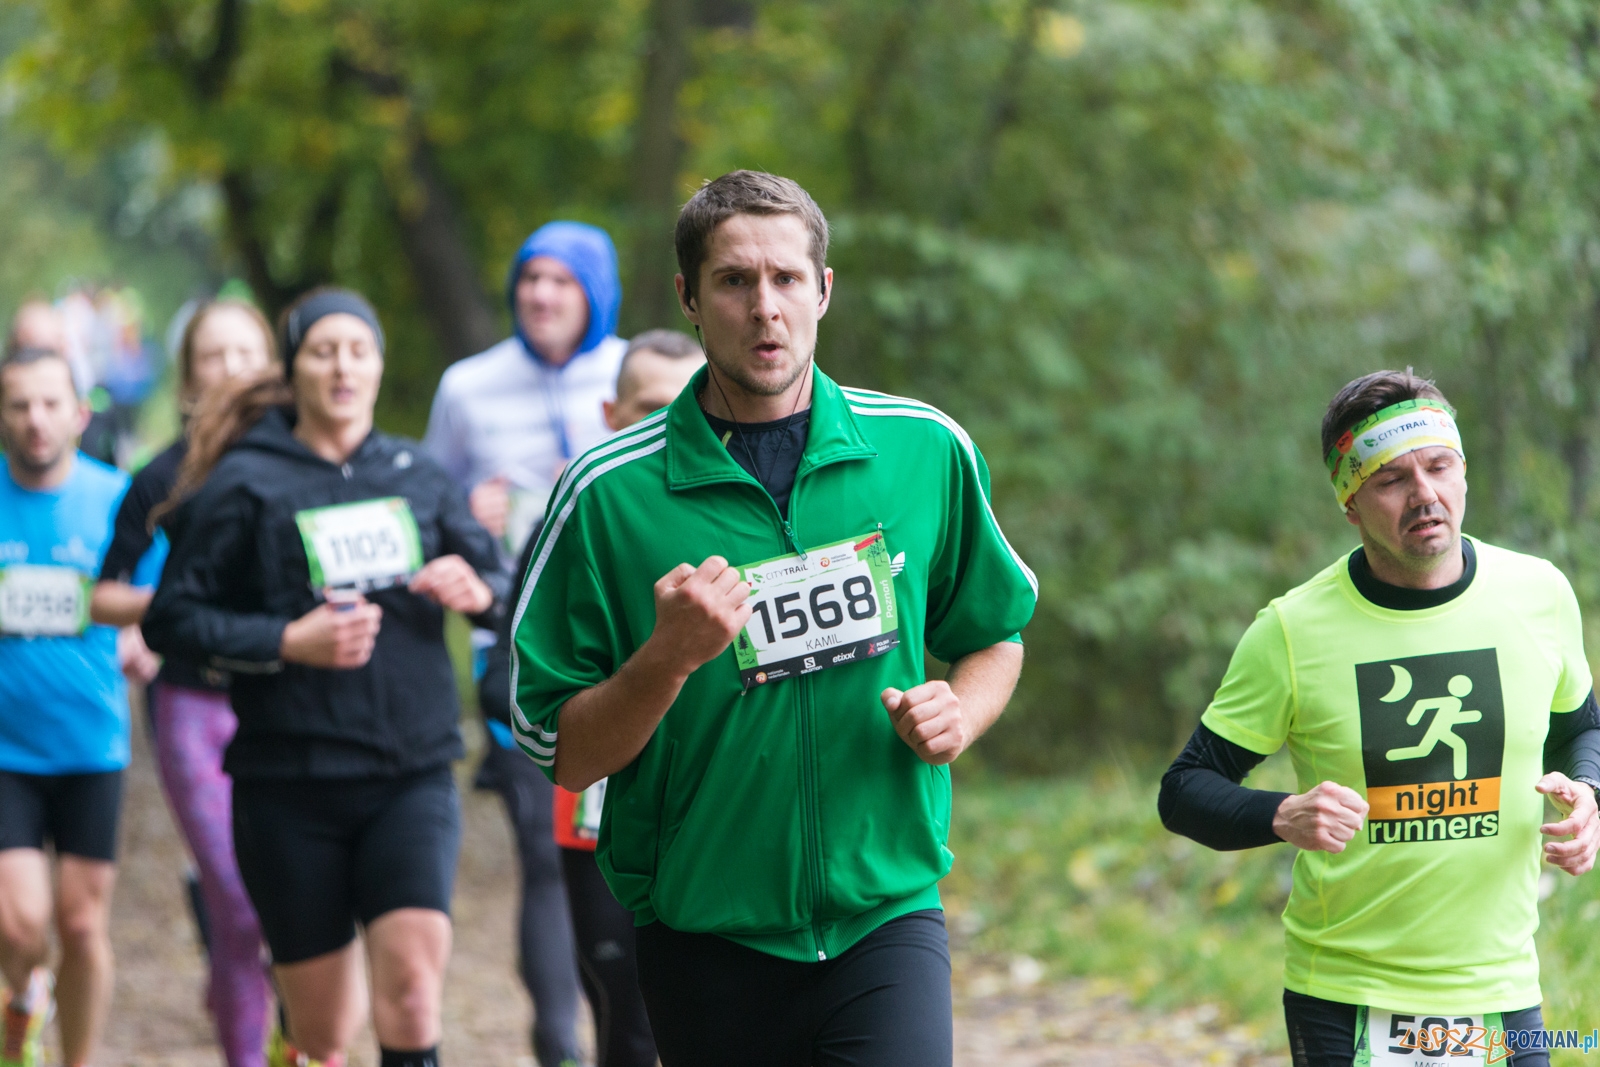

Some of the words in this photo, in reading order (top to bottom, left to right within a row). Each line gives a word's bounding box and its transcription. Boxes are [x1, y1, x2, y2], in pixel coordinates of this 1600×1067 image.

[330, 528, 397, 567] 1105
[752, 575, 877, 644] 1568
[880, 579, 893, 618] Poznań
[805, 634, 842, 651] KAMIL
[1396, 782, 1478, 816] night
[1370, 813, 1498, 843] runners
[1388, 1013, 1474, 1058] 502
